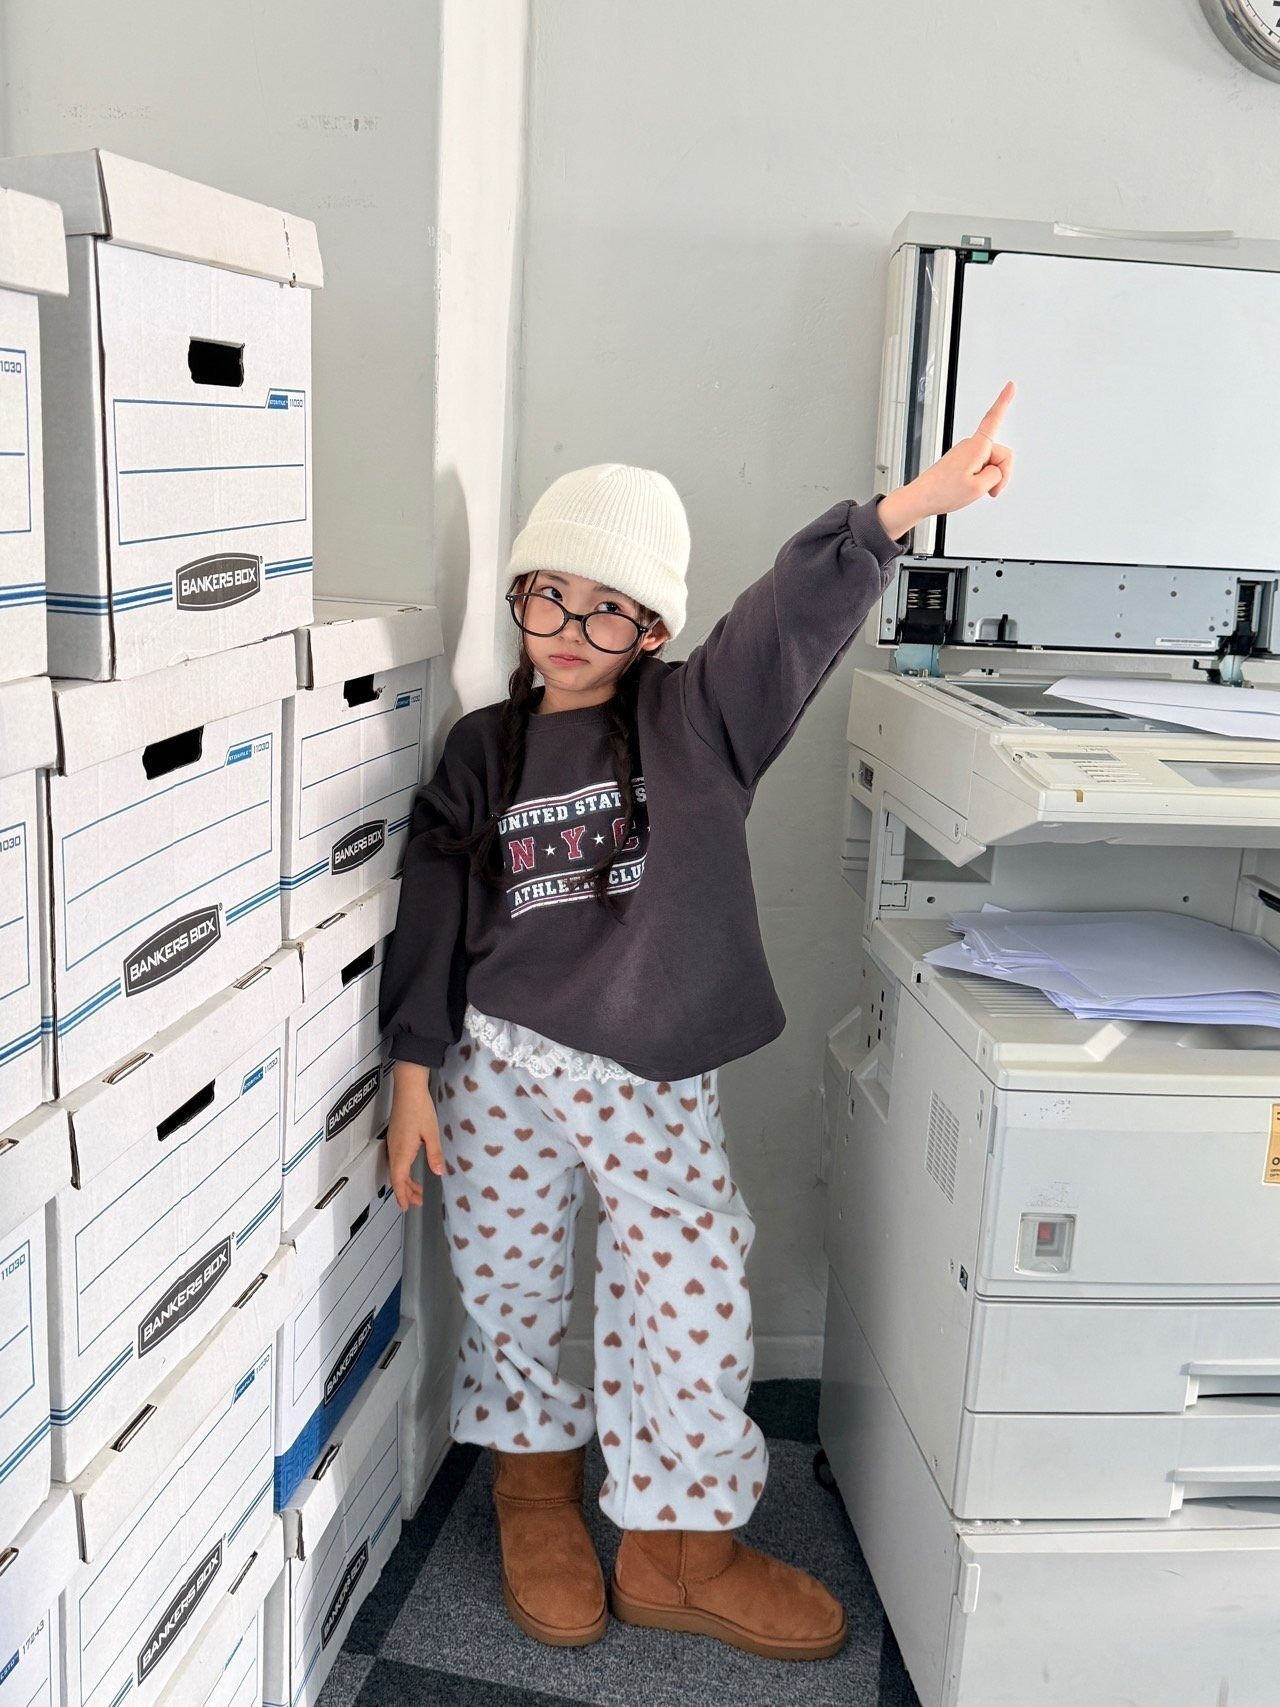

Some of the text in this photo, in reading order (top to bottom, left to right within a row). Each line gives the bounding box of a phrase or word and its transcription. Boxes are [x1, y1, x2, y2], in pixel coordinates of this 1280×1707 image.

[181, 566, 257, 597] BANKERS BOX
[253, 741, 270, 754] 11030
[497, 787, 647, 835] UNITED STATS
[334, 829, 383, 865] BANKERS BOX
[508, 837, 535, 874] N
[560, 825, 586, 860] Y
[130, 916, 216, 982] BANKERS BOX
[328, 1074, 378, 1131] BANKERS BOX
[1, 1253, 26, 1281] 11030
[143, 1248, 228, 1343] BANKERS BOX
[326, 1320, 372, 1397] BANKERS BOX
[142, 1551, 219, 1670] BANKERS BOX
[22, 1619, 45, 1655] 17243
